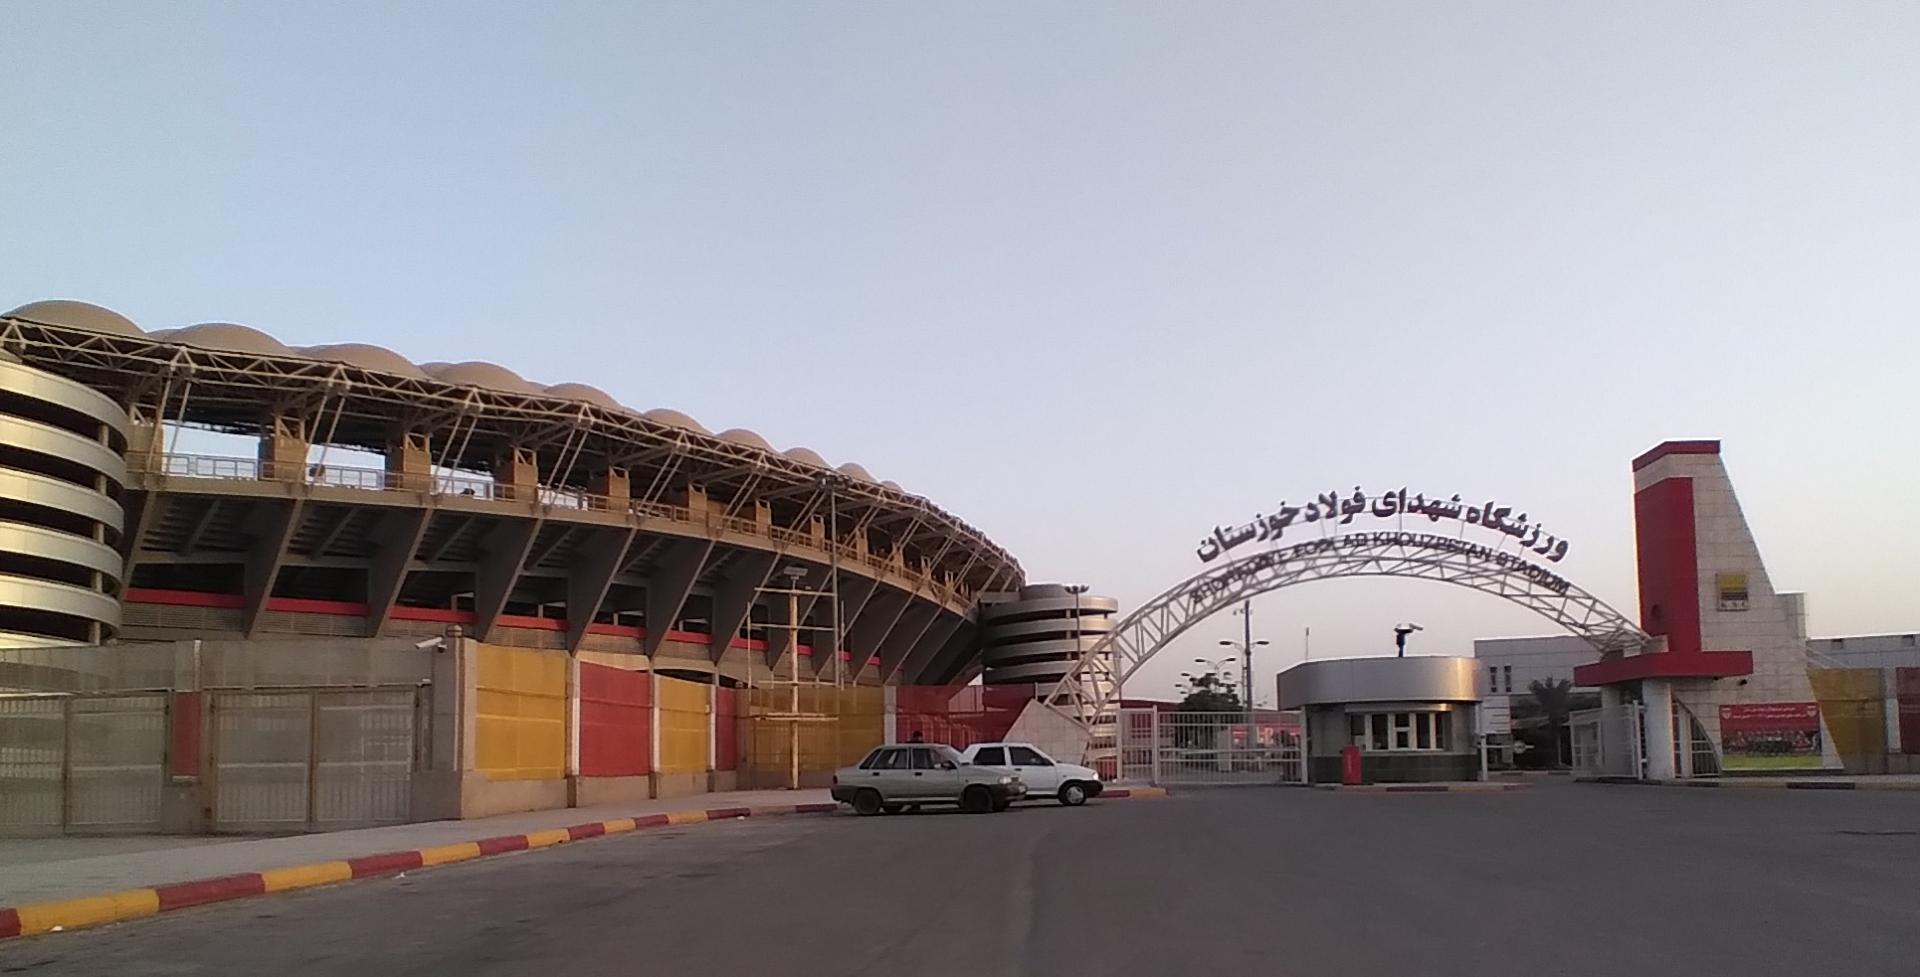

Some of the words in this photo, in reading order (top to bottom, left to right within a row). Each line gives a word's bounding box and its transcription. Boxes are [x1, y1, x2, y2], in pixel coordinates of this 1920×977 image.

[1304, 485, 1366, 525] فولاد
[1371, 486, 1463, 523] شهدای
[1196, 500, 1300, 564] خوزستان
[1465, 500, 1570, 564] ورزشگاه
[1496, 551, 1571, 596] STADIUM
